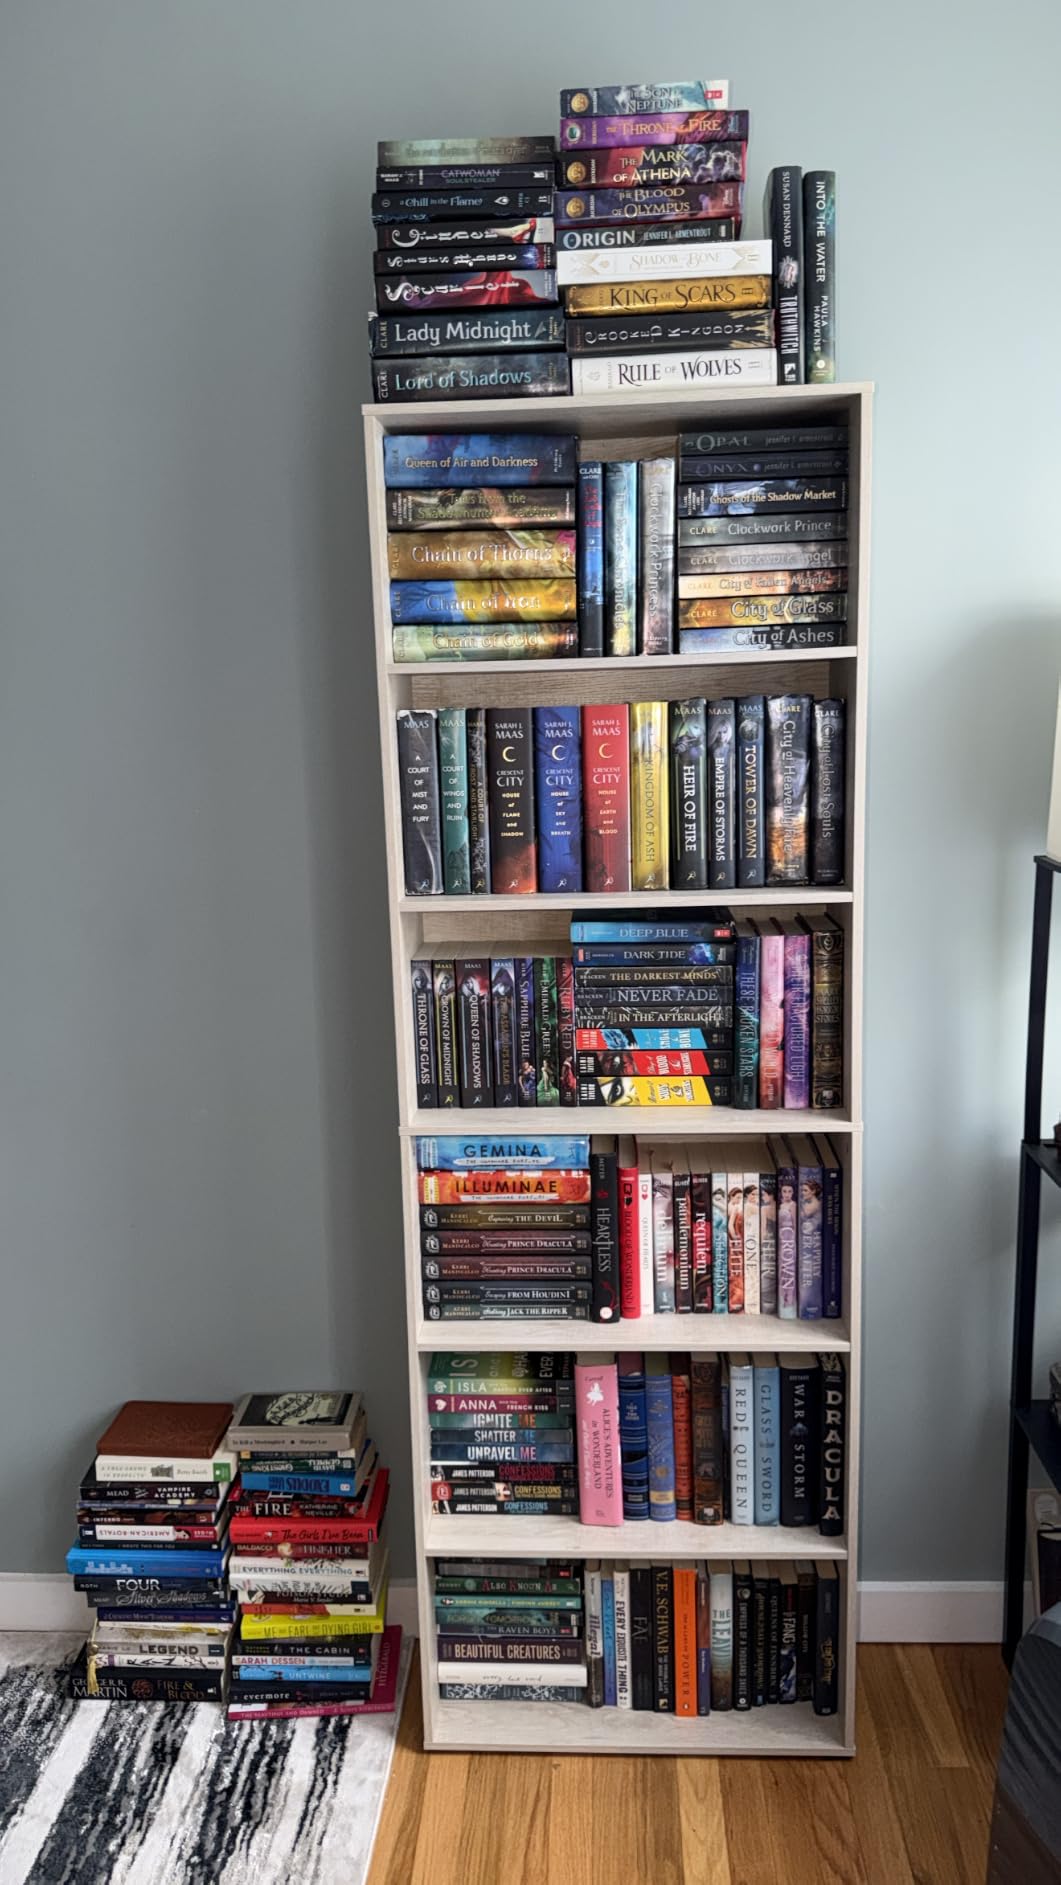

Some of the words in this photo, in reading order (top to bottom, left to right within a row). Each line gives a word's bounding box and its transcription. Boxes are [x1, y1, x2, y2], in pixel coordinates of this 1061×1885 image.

[620, 158, 637, 168] THE
[640, 150, 688, 164] MARK
[441, 169, 500, 178] CATWOMAN
[613, 173, 628, 182] OF
[631, 168, 691, 180] ATHENA
[782, 171, 790, 202] SUSAN
[816, 182, 825, 209] INTO
[392, 229, 498, 247] Cinder
[783, 204, 792, 248] DENNARD
[816, 216, 825, 236] THE
[563, 230, 635, 249] ORIGIN
[816, 243, 825, 282] WATER
[385, 282, 519, 301] Scarlet
[610, 287, 658, 310] KING
[675, 284, 735, 309] SCARS
[395, 324, 440, 346] Lady
[446, 320, 530, 344] Midnight
[585, 325, 663, 344] CROOKED
[668, 325, 745, 337] KINGDOM
[780, 296, 798, 354] TRUTHWITCH
[814, 306, 822, 352] HAWKINS
[396, 374, 433, 391] Lord
[439, 372, 456, 387] of
[460, 371, 531, 386] Shadows
[618, 363, 661, 386] RULE
[665, 366, 676, 374] OF
[680, 355, 742, 380] WOLVES
[406, 457, 438, 469] Queen
[440, 457, 451, 467] of
[453, 457, 468, 467] Air
[470, 457, 489, 466] and
[492, 456, 538, 466] Darkness
[710, 495, 740, 504] Ghosts
[752, 494, 765, 502] the
[768, 492, 802, 502] Shadow
[804, 489, 836, 499] Market
[649, 483, 663, 557] Clockwork
[690, 527, 717, 535] CLARE
[728, 522, 791, 535] Clockwork
[795, 520, 831, 531] Prince
[412, 546, 462, 563] Chain
[468, 548, 484, 561] of
[490, 544, 551, 560] Thorns
[649, 559, 662, 617] Princess
[734, 631, 767, 649] City
[771, 630, 785, 641] of
[787, 629, 834, 643] Ashes
[674, 707, 701, 715] MAAS
[404, 720, 429, 729] MAAS
[495, 730, 524, 739] MAAS
[545, 729, 573, 738] MAAS
[592, 727, 621, 736] MAAS
[497, 776, 524, 787] CITY
[545, 775, 573, 786] CITY
[593, 774, 621, 784] CITY
[683, 765, 695, 798] HEIR
[716, 758, 725, 798] EMPIRE
[745, 746, 756, 794] TOWER
[645, 759, 655, 819] KINGDOM
[684, 801, 696, 819] OF
[716, 800, 725, 815] OF
[746, 798, 756, 816] OF
[646, 822, 655, 837] OF
[685, 822, 696, 852] FIRE
[716, 817, 725, 861] STORMS
[746, 819, 756, 858] DAWN
[646, 841, 655, 862] ASH
[619, 929, 653, 937] DEEP
[655, 929, 689, 938] BLUE
[624, 951, 654, 959] DARK
[657, 951, 686, 960] TIDE
[519, 980, 530, 1029] SAPPHIRE
[540, 980, 550, 1022] EMERALD
[559, 986, 572, 1020] RUBY
[618, 990, 673, 1002] NEVER
[677, 990, 718, 1000] FADE
[417, 993, 427, 1037] THRONE
[441, 995, 449, 1029] CROWN
[469, 995, 478, 1027] QUEEN
[419, 1038, 429, 1054] OF
[442, 1030, 450, 1041] OF
[471, 1029, 480, 1041] OF
[520, 1032, 530, 1058] BLUE
[541, 1023, 551, 1057] GREEN
[561, 1023, 572, 1049] RED
[420, 1054, 430, 1084] GLASS
[442, 1042, 452, 1086] MIDNIGHT
[471, 1042, 481, 1089] SHADOWS
[464, 1145, 542, 1158] GEMINA
[455, 1181, 557, 1193] ILLUMINAE
[592, 1208, 614, 1272] HEARTLESS
[657, 1211, 672, 1282] delirium
[675, 1197, 691, 1290] pandemonium
[693, 1212, 710, 1274] requiem
[532, 1291, 570, 1299] HOUDINI
[507, 1308, 524, 1316] JACK
[458, 1382, 487, 1393] ISLA
[459, 1400, 497, 1410] ANNA
[736, 1388, 746, 1423] RED
[761, 1384, 771, 1435] GLASS
[794, 1385, 805, 1418] WAR
[474, 1431, 516, 1442] SHATTER
[602, 1408, 612, 1439] ALICE'S
[467, 1447, 519, 1460] UNRAVEL
[520, 1447, 536, 1460] ME
[824, 1390, 842, 1520] DRACULA
[604, 1440, 613, 1498] ADVENTURES
[733, 1444, 748, 1509] QUEEN
[794, 1444, 805, 1498] STORM
[761, 1457, 772, 1511] SWORD
[255, 1504, 292, 1516] FIRE
[242, 1566, 296, 1574] EVERYTHING
[299, 1567, 352, 1575] EVERYTHING
[116, 1580, 160, 1591] FOUR
[616, 1601, 625, 1631] EVERY
[656, 1599, 669, 1654] SCHWAB
[713, 1609, 730, 1618] THE
[588, 1615, 601, 1657] Illegal
[632, 1616, 648, 1642] FAE
[782, 1616, 796, 1644] FANG
[139, 1645, 199, 1655] LEGEND
[455, 1644, 504, 1659] BEAUTIFUL
[507, 1645, 560, 1659] CREATURES
[616, 1632, 626, 1662] EXQUISITE
[235, 1656, 268, 1665] SARAH
[271, 1657, 305, 1665] DESSEN
[618, 1665, 628, 1693] THING
